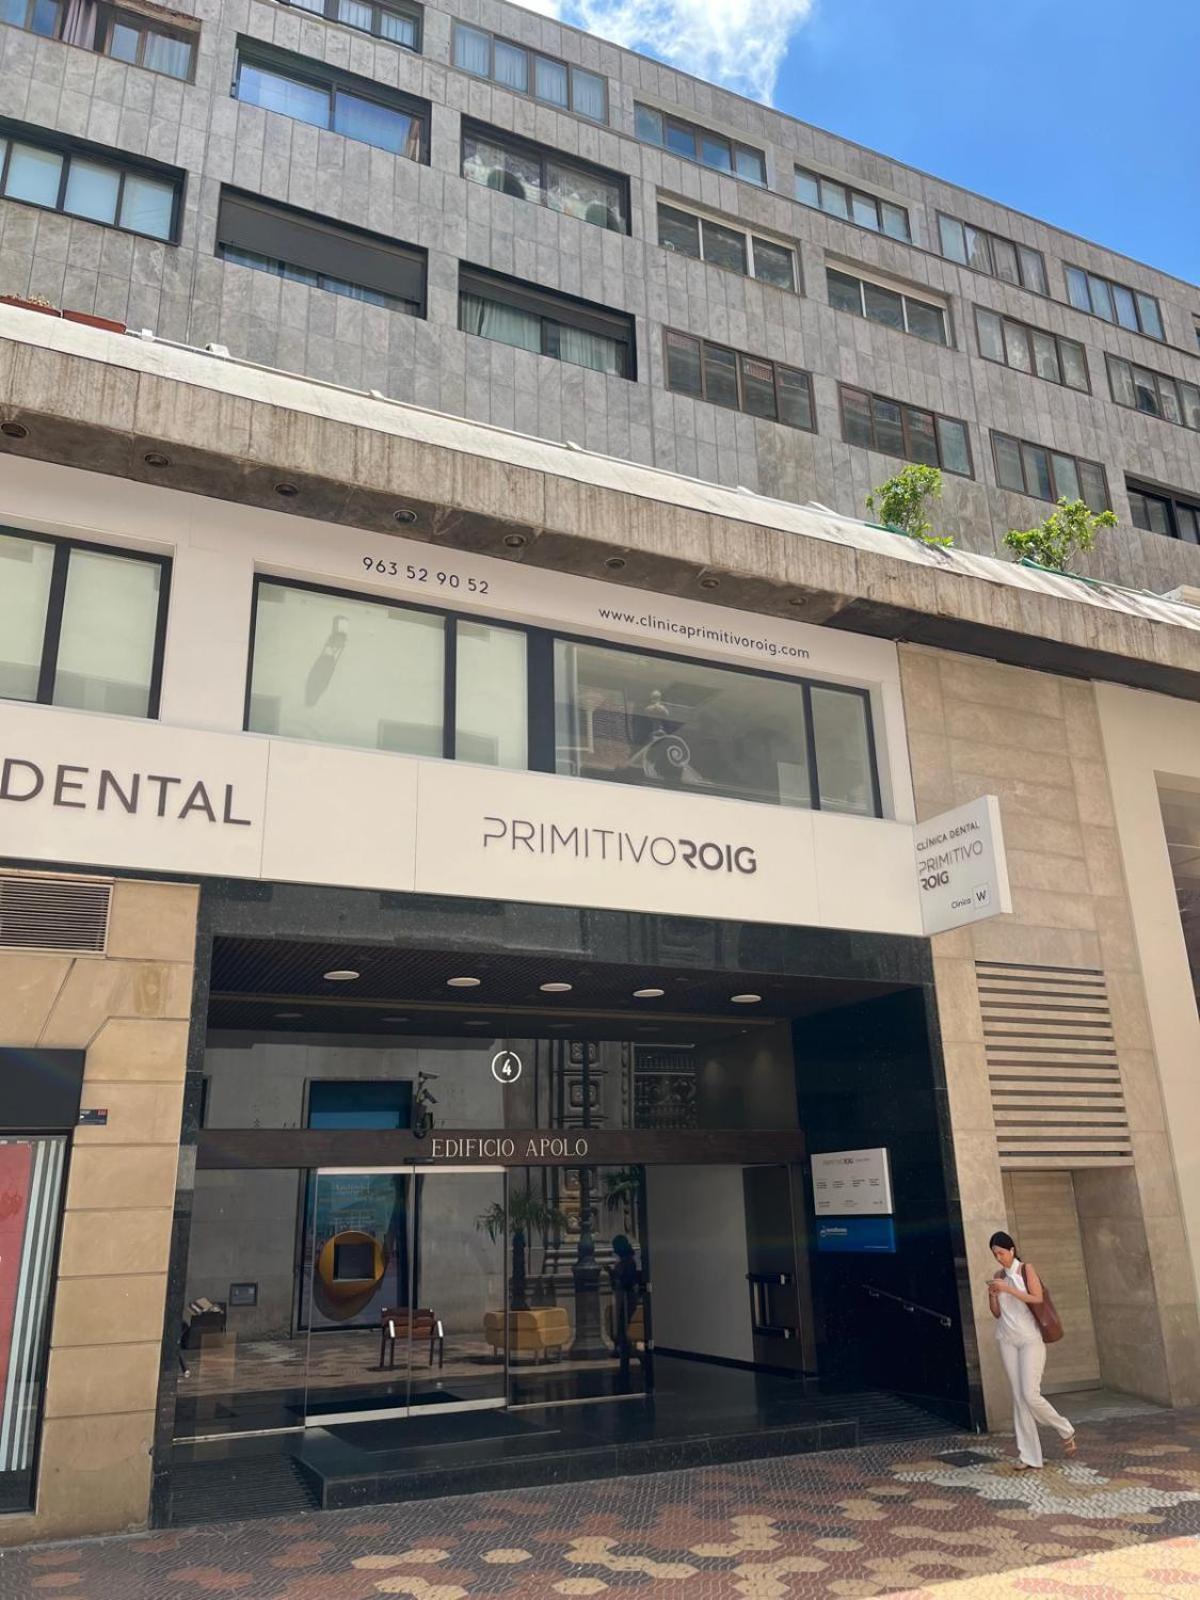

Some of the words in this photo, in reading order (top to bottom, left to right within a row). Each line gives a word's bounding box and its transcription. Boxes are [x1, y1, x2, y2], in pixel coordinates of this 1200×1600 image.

[362, 555, 399, 577] 963
[406, 564, 429, 582] 52
[436, 571, 460, 589] 90
[467, 577, 490, 595] 52
[598, 608, 810, 660] www.clinicaprimitivoroig.com
[0, 757, 252, 826] DENTAL
[916, 833, 948, 852] CLÍNICA
[949, 821, 980, 839] DENTAL
[919, 840, 983, 874] PRIMITIVO
[920, 870, 950, 892] ROIG
[975, 889, 987, 902] W
[502, 1058, 512, 1077] 4
[431, 1138, 515, 1158] EDIFICIO
[525, 1138, 588, 1157] APOLO
